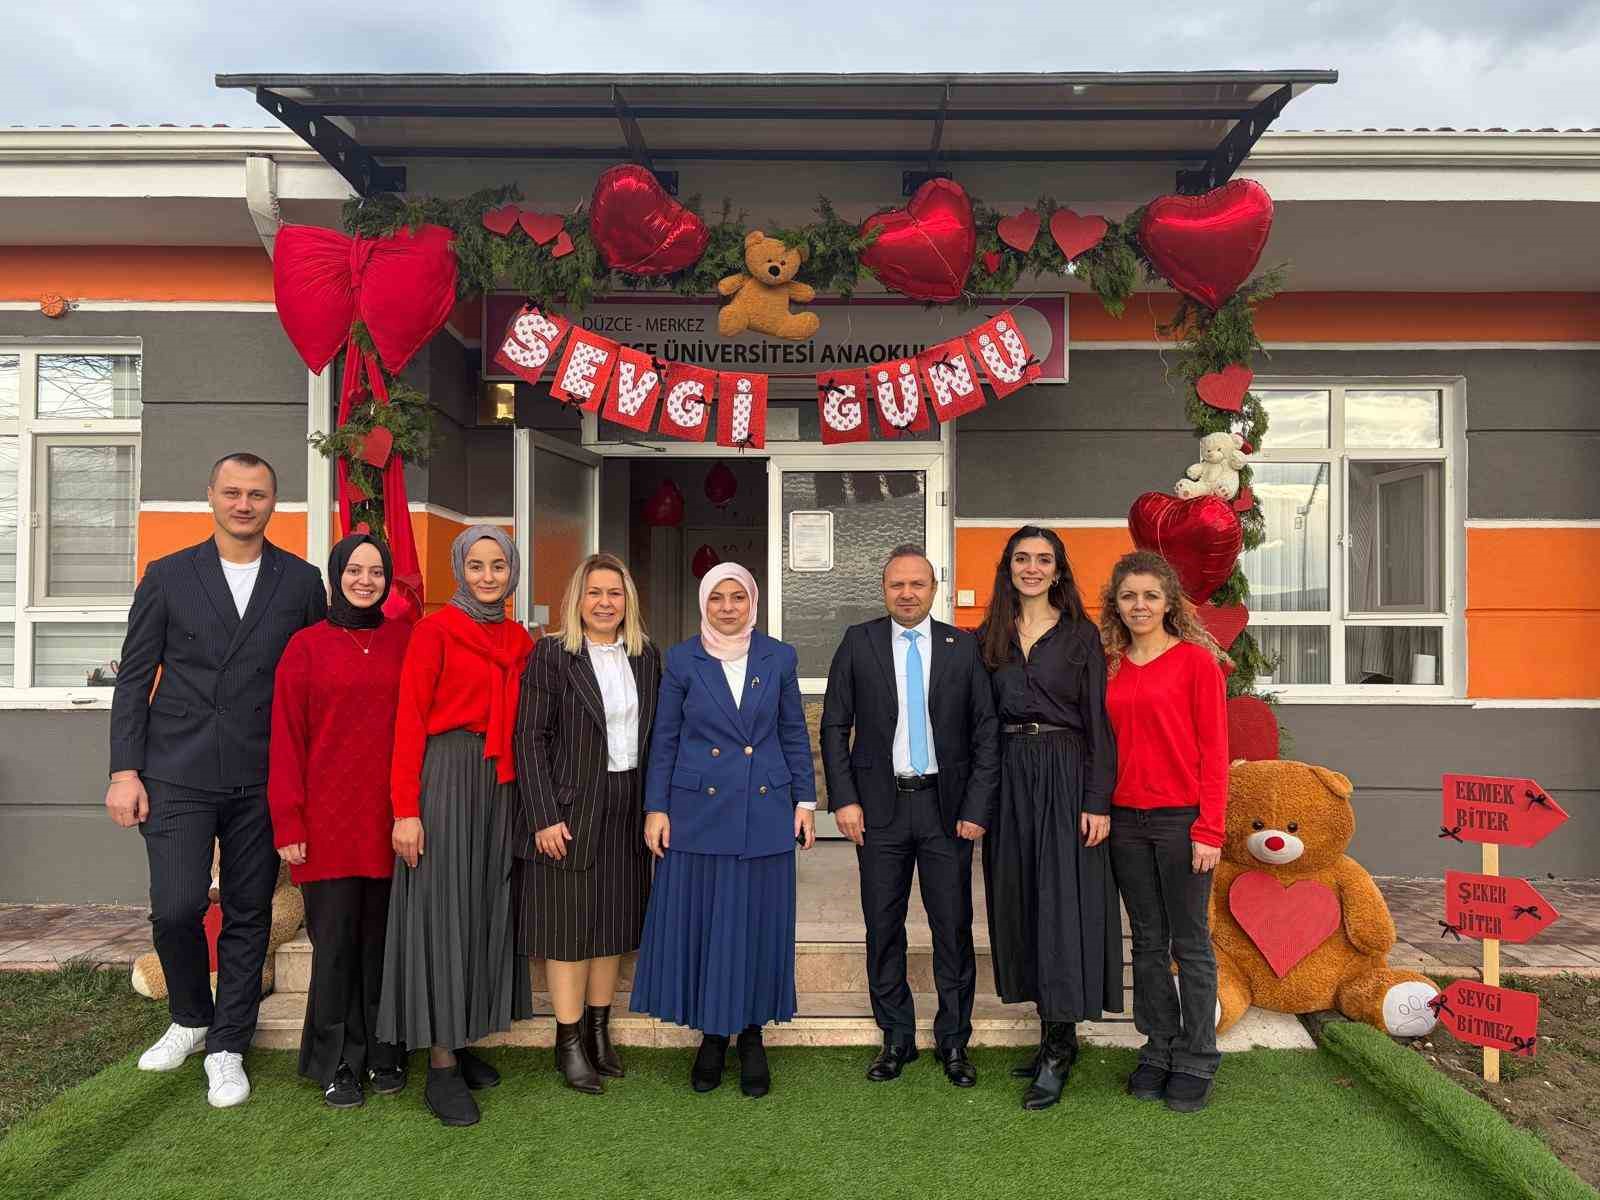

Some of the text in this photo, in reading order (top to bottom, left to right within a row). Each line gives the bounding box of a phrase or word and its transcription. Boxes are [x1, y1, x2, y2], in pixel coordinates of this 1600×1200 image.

[582, 314, 632, 332] DÜZCE
[646, 318, 705, 332] MERKEZ
[664, 339, 814, 364] ÜNİVERSİTESİ
[820, 343, 926, 363] ANAOKU
[502, 312, 1028, 443] SEVGİ GÜNÜ
[1455, 780, 1515, 805] EKMEK
[1456, 806, 1510, 832] BİTER
[1458, 882, 1507, 905] ŞEKER
[1458, 910, 1502, 935] BİTER
[1457, 987, 1502, 1013] SEVGİ
[1457, 1014, 1514, 1043] BİTMEZ
